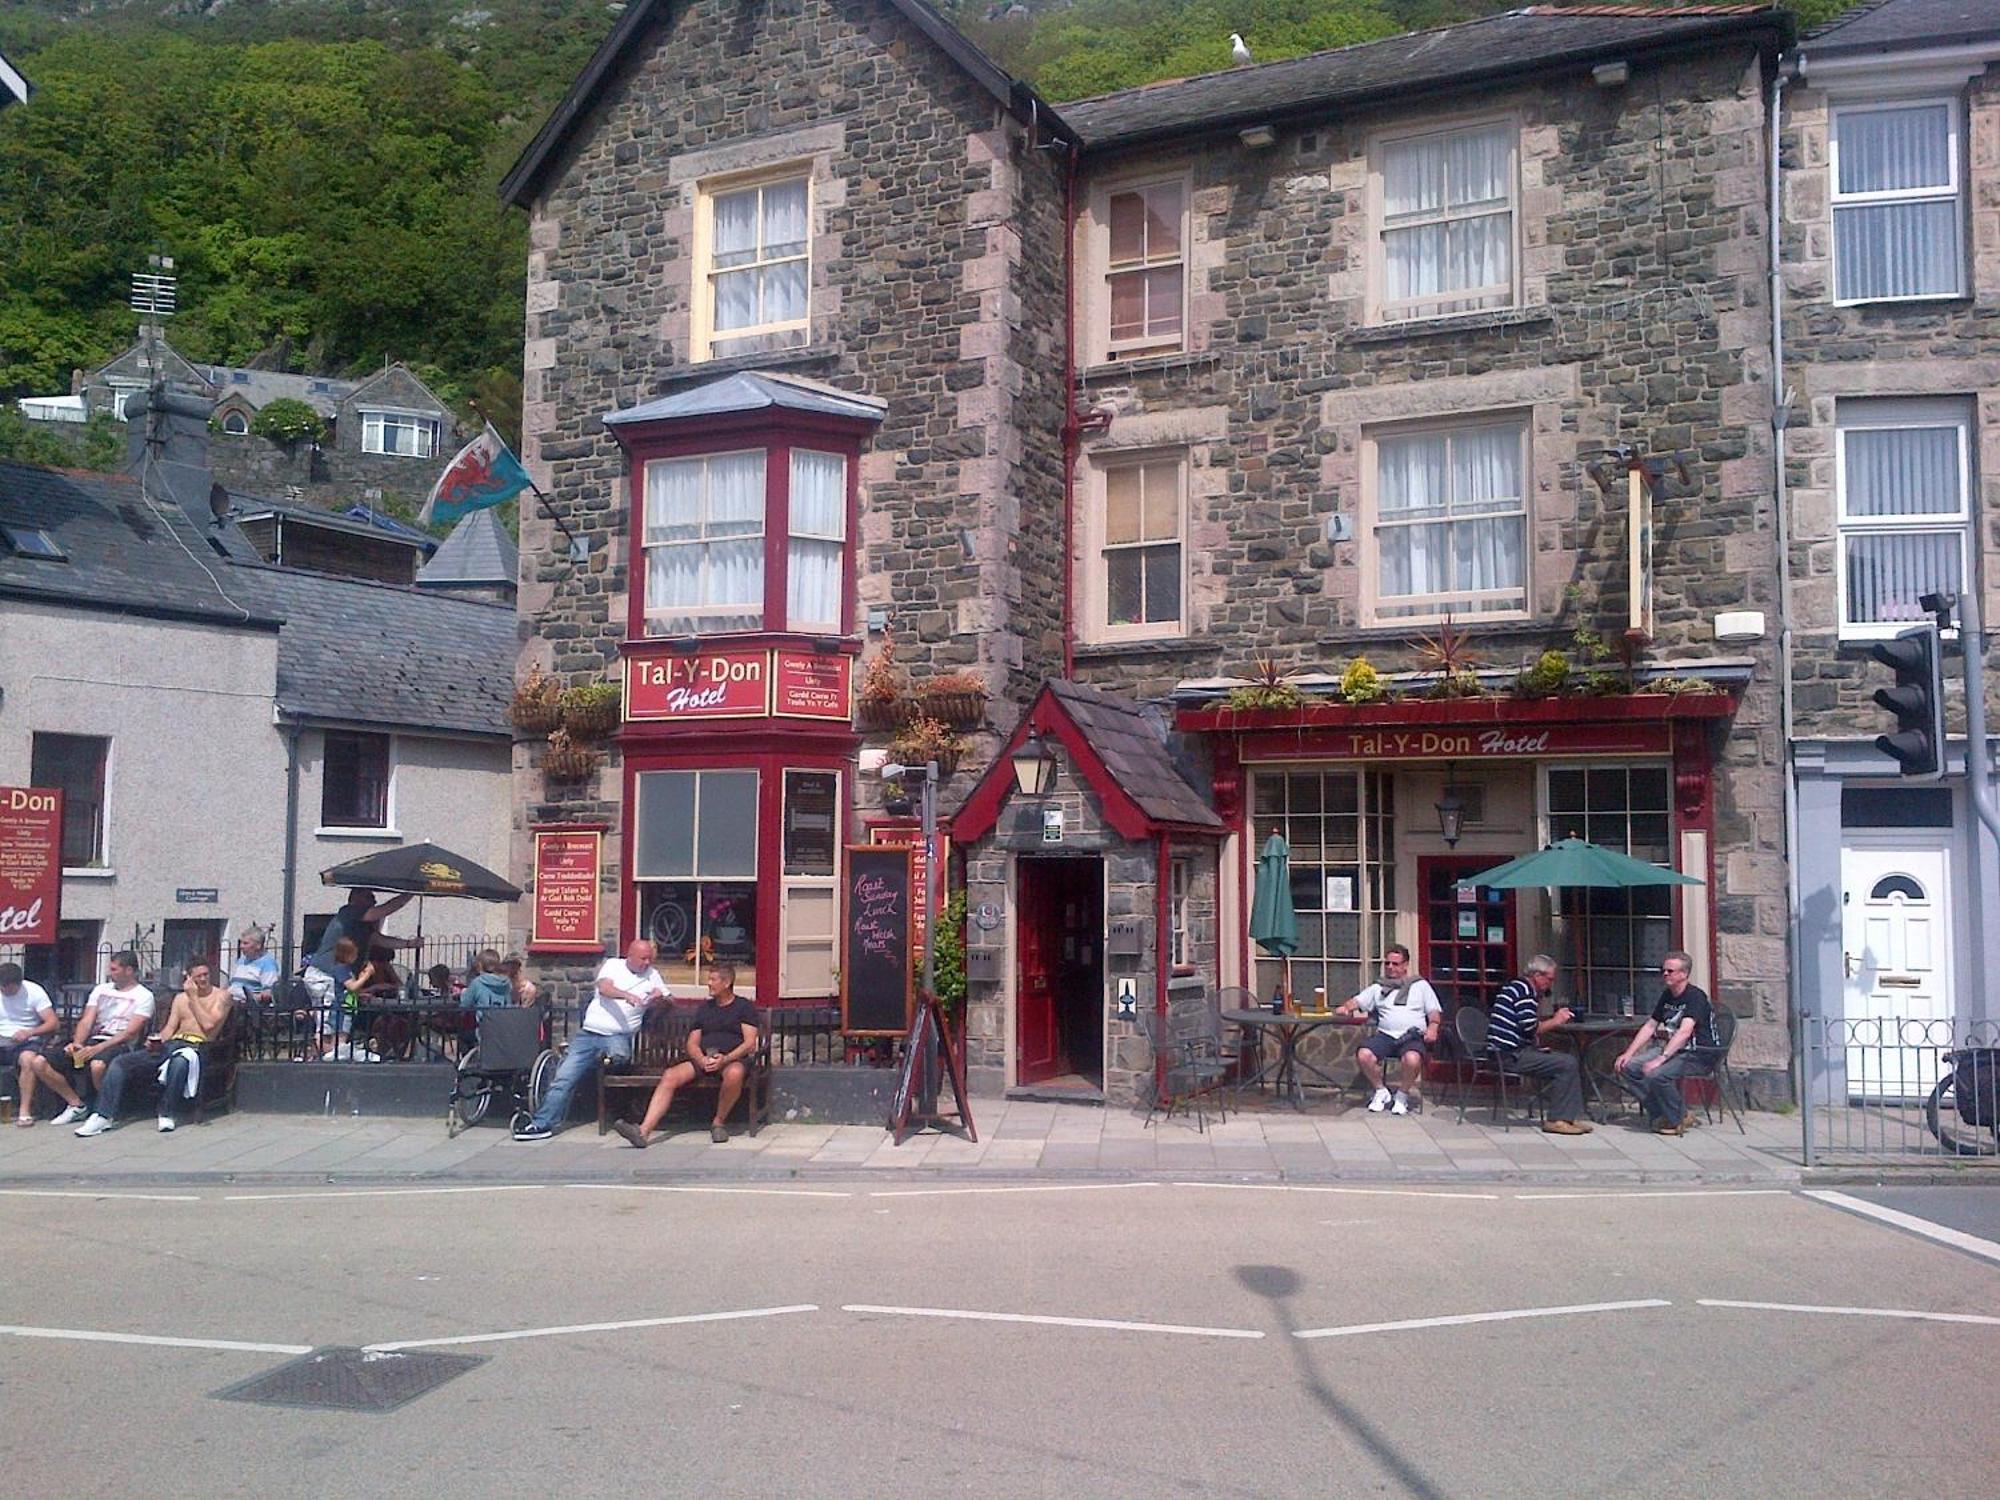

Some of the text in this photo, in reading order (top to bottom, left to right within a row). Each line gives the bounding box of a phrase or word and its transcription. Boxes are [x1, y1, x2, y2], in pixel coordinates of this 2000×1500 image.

[637, 658, 760, 685] Tal-Y-Don
[666, 682, 726, 713] Hotel
[1349, 731, 1550, 755] Tal-Y-Don Hotel
[854, 873, 885, 896] Roast
